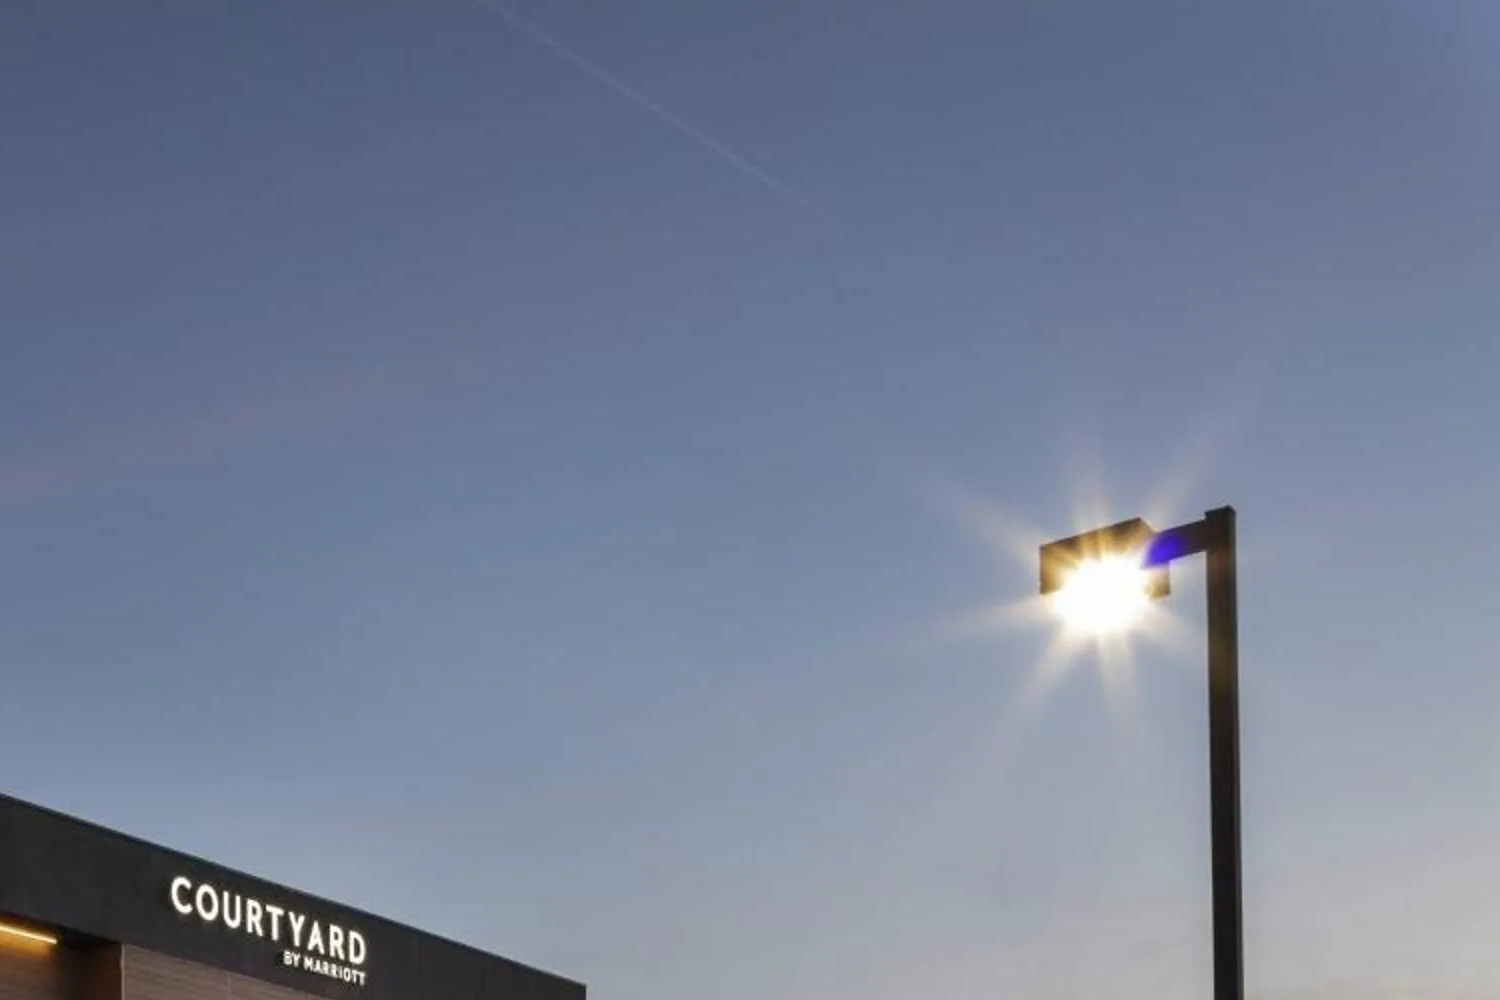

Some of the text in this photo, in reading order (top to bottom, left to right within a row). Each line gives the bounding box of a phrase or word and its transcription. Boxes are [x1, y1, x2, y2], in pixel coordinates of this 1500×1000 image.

[171, 876, 366, 965] COURTYARD
[283, 949, 366, 986] BY MARRIOTT
